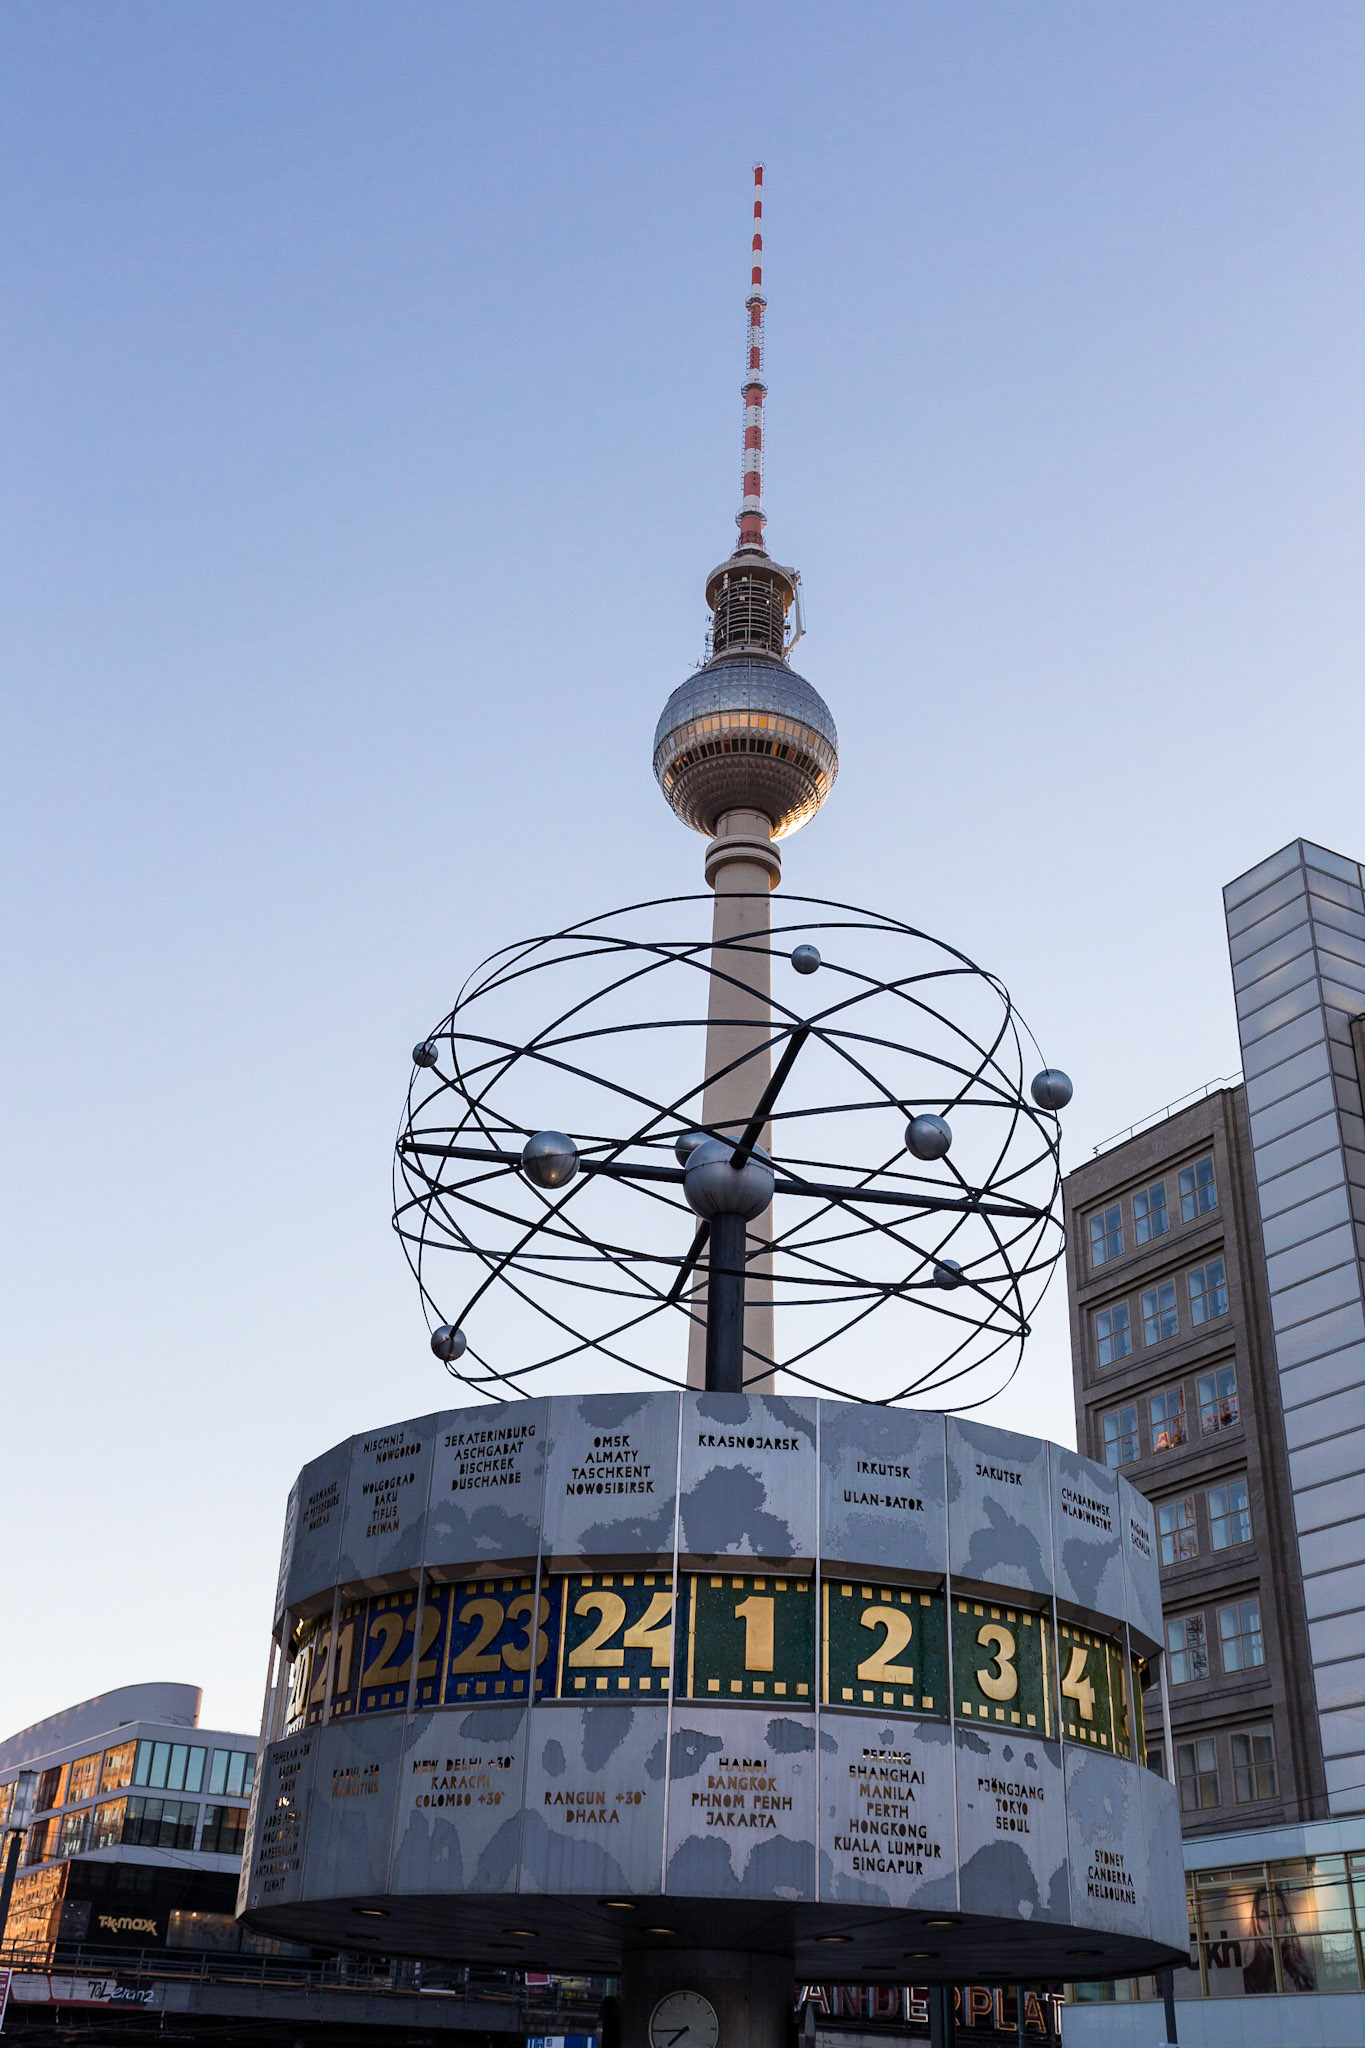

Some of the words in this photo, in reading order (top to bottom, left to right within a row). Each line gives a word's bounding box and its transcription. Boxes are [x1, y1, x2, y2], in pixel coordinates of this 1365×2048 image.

[363, 1433, 404, 1454] NISCHNIJ
[444, 1425, 536, 1447] JEKATERINBURG
[593, 1435, 631, 1448] OMSK
[698, 1434, 800, 1451] KRASNOJARSK
[375, 1442, 421, 1464] NOWGOROD
[454, 1441, 524, 1461] ASCHGABAT
[585, 1450, 639, 1464] ALMATY
[459, 1457, 515, 1475] BISCHKEK
[571, 1465, 651, 1480] TASCHKENT
[856, 1461, 911, 1479] IRKUTSK
[975, 1463, 1023, 1487] JAKUTSK
[362, 1472, 415, 1495] WOLGOGRAD
[451, 1471, 522, 1491] DUSCHANBE
[566, 1481, 655, 1496] NOWOSIBIRSK
[374, 1491, 398, 1507] BAKU
[843, 1490, 925, 1512] ULAN-BATOR
[1061, 1487, 1111, 1518] CHABAROWSK
[372, 1506, 397, 1522] TIFLIS
[1061, 1501, 1113, 1533] WLADIWOSTOK
[366, 1519, 399, 1538] ERIWAN
[452, 1593, 551, 1675] 23
[568, 1591, 679, 1668] 24
[734, 1595, 775, 1672] 1
[362, 1605, 441, 1688] 22
[857, 1605, 914, 1685] 2
[310, 1623, 355, 1704] 21
[975, 1623, 1018, 1701] 3
[1061, 1646, 1096, 1720] 4
[412, 1758, 439, 1773] NEW
[446, 1757, 482, 1772] DELHI
[719, 1758, 767, 1773] HANOI
[862, 1748, 912, 1766] PEKING
[279, 1762, 301, 1779] BAGDAD
[332, 1767, 361, 1783] KABUL
[849, 1765, 925, 1785] SHANGHAI
[280, 1778, 296, 1792] ADEN
[331, 1781, 379, 1799] MAURITIUS
[431, 1774, 491, 1790] KARACHI
[707, 1775, 778, 1792] BANGKOK
[977, 1777, 1044, 1801] PJÖNGJANG
[415, 1793, 472, 1808] COLOMBO
[544, 1791, 606, 1806] RANGUN
[859, 1783, 916, 1801] MANILA
[691, 1792, 745, 1809] PHNOM
[753, 1795, 793, 1811] PENH
[866, 1802, 909, 1819] PERTH
[995, 1799, 1029, 1816] TOKYO
[264, 1813, 282, 1829] ADDIS
[565, 1809, 620, 1824] DHAKA
[706, 1812, 777, 1828] JAKARTA
[995, 1816, 1031, 1834] SEOUL
[849, 1819, 928, 1839] HONGKONG
[834, 1836, 881, 1853] KUALA
[887, 1840, 942, 1858] LUMPUR
[852, 1857, 924, 1876] SINGAPUR
[1094, 1849, 1125, 1868] SYDNEY
[264, 1877, 285, 1893] KUWAIT
[1087, 1865, 1134, 1888] CANBERRA
[1087, 1882, 1136, 1905] MELBOURNE
